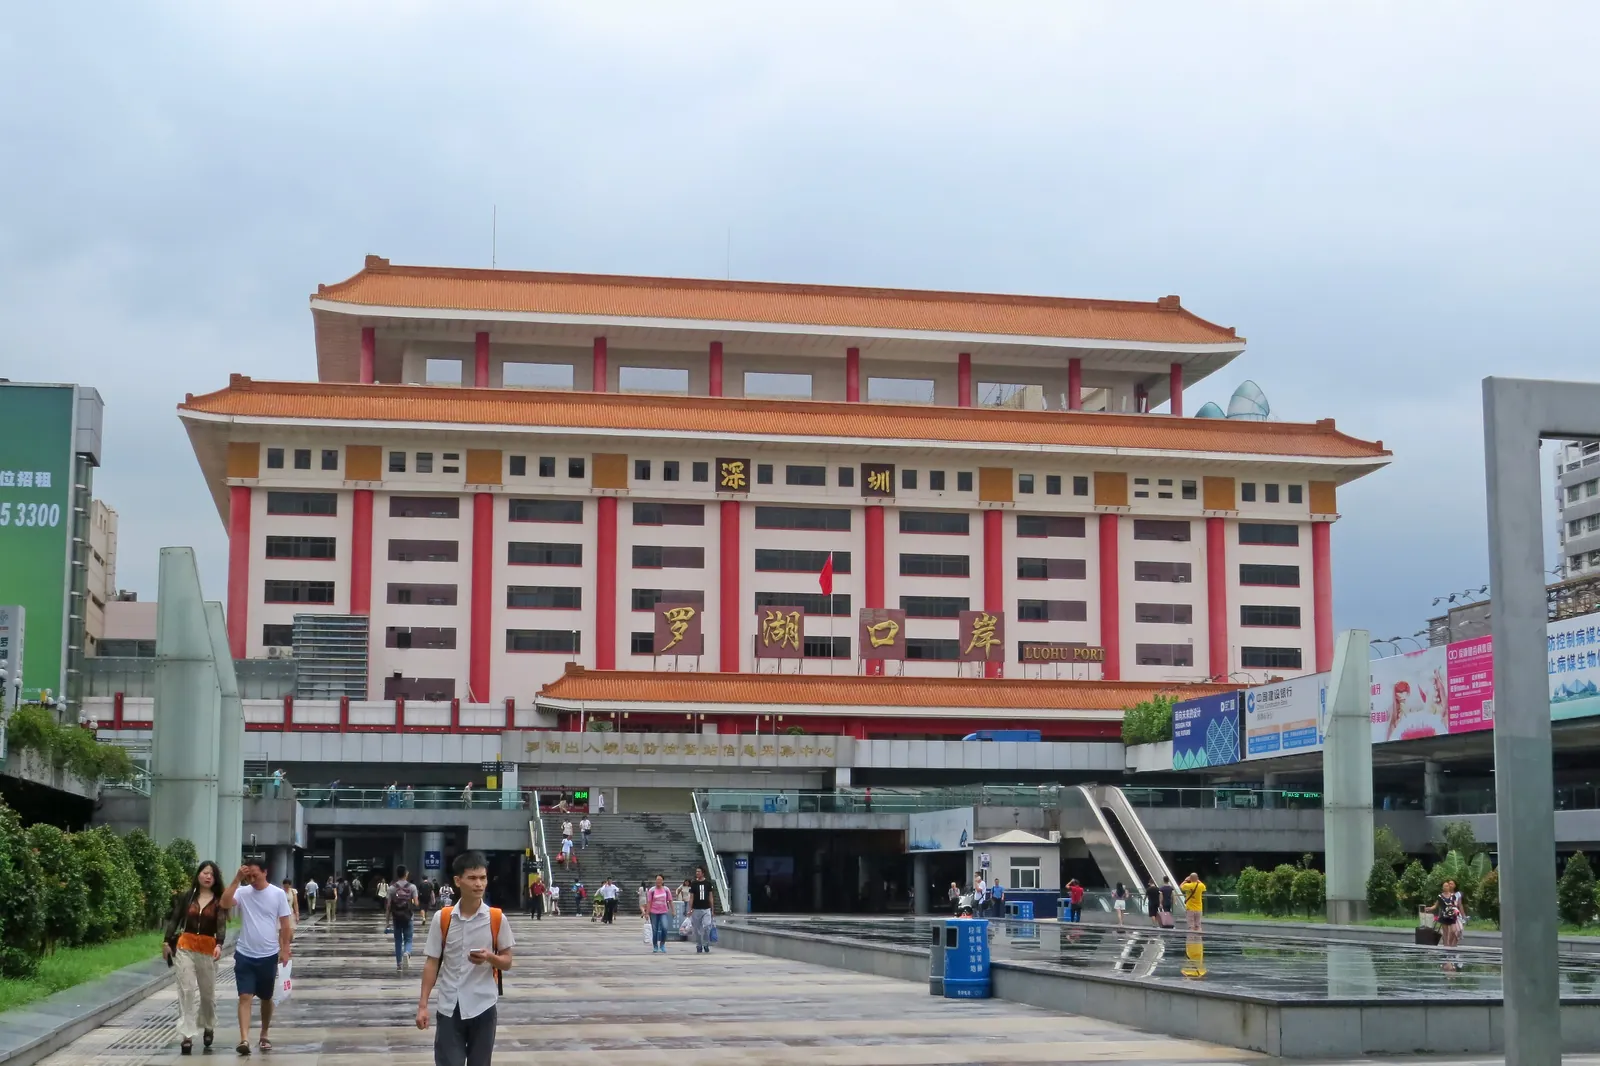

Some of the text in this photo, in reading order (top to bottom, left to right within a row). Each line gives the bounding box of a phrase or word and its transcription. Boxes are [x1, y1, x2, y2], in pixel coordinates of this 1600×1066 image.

[0, 470, 52, 488] 位招租
[14, 502, 60, 527] 3300
[1024, 647, 1105, 661] LUOHU PORT
[1256, 686, 1293, 703] 中国建设银行
